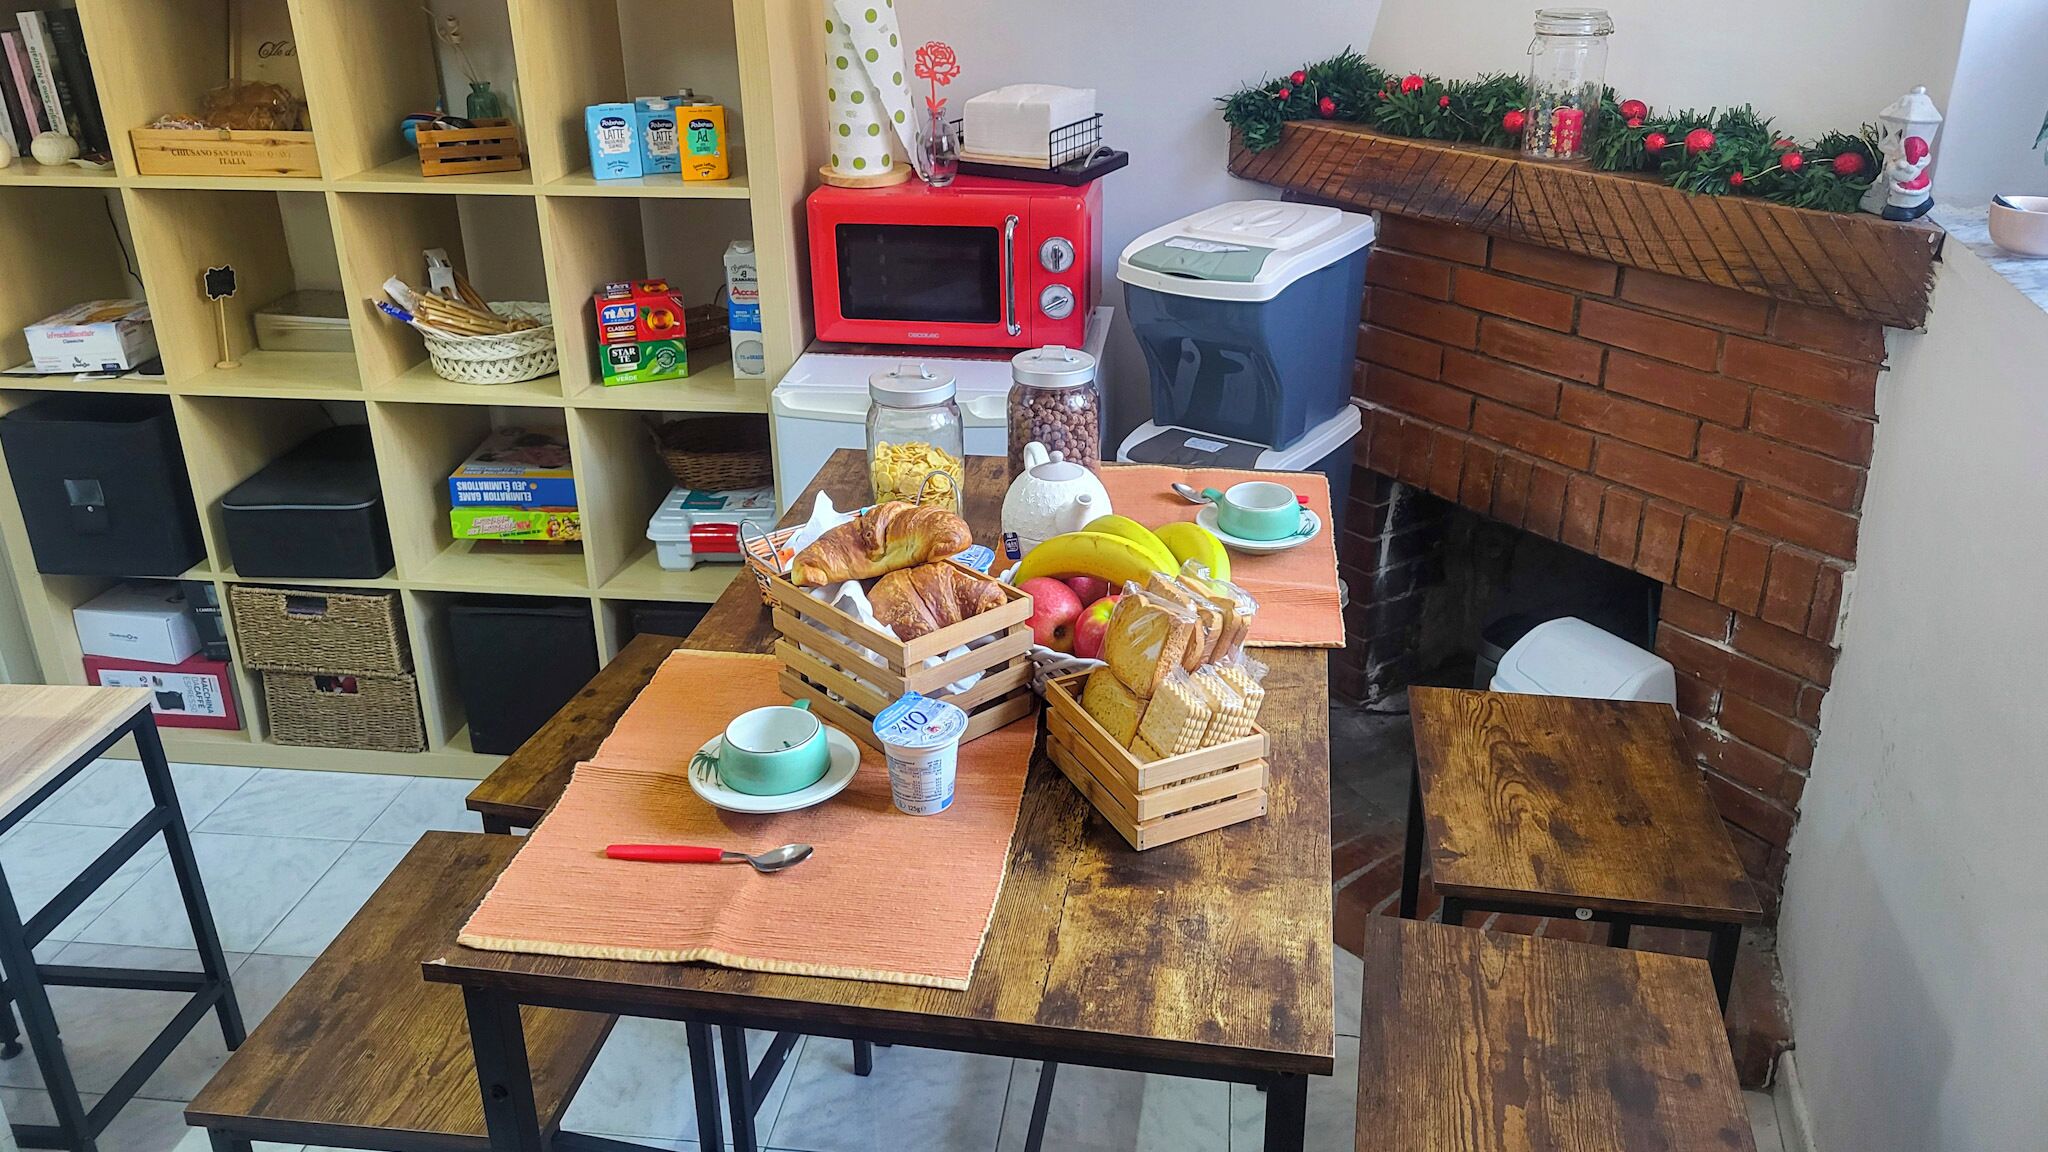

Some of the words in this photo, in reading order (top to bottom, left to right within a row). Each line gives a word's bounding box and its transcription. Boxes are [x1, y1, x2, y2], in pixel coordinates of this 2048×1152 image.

[30, 46, 43, 78] Naturale
[42, 86, 51, 104] Sano
[603, 129, 625, 140] LATTE
[651, 130, 673, 142] LATTE
[171, 148, 212, 157] CHIUSANO
[213, 149, 229, 157] SAN
[731, 286, 759, 296] Accad
[612, 347, 637, 357] STAR
[456, 481, 511, 492] ÉLIMINATIONS
[511, 481, 527, 491] JEU
[457, 491, 482, 501] GAME
[482, 491, 532, 501] ELIMINATION
[200, 677, 214, 714] MACCHINA
